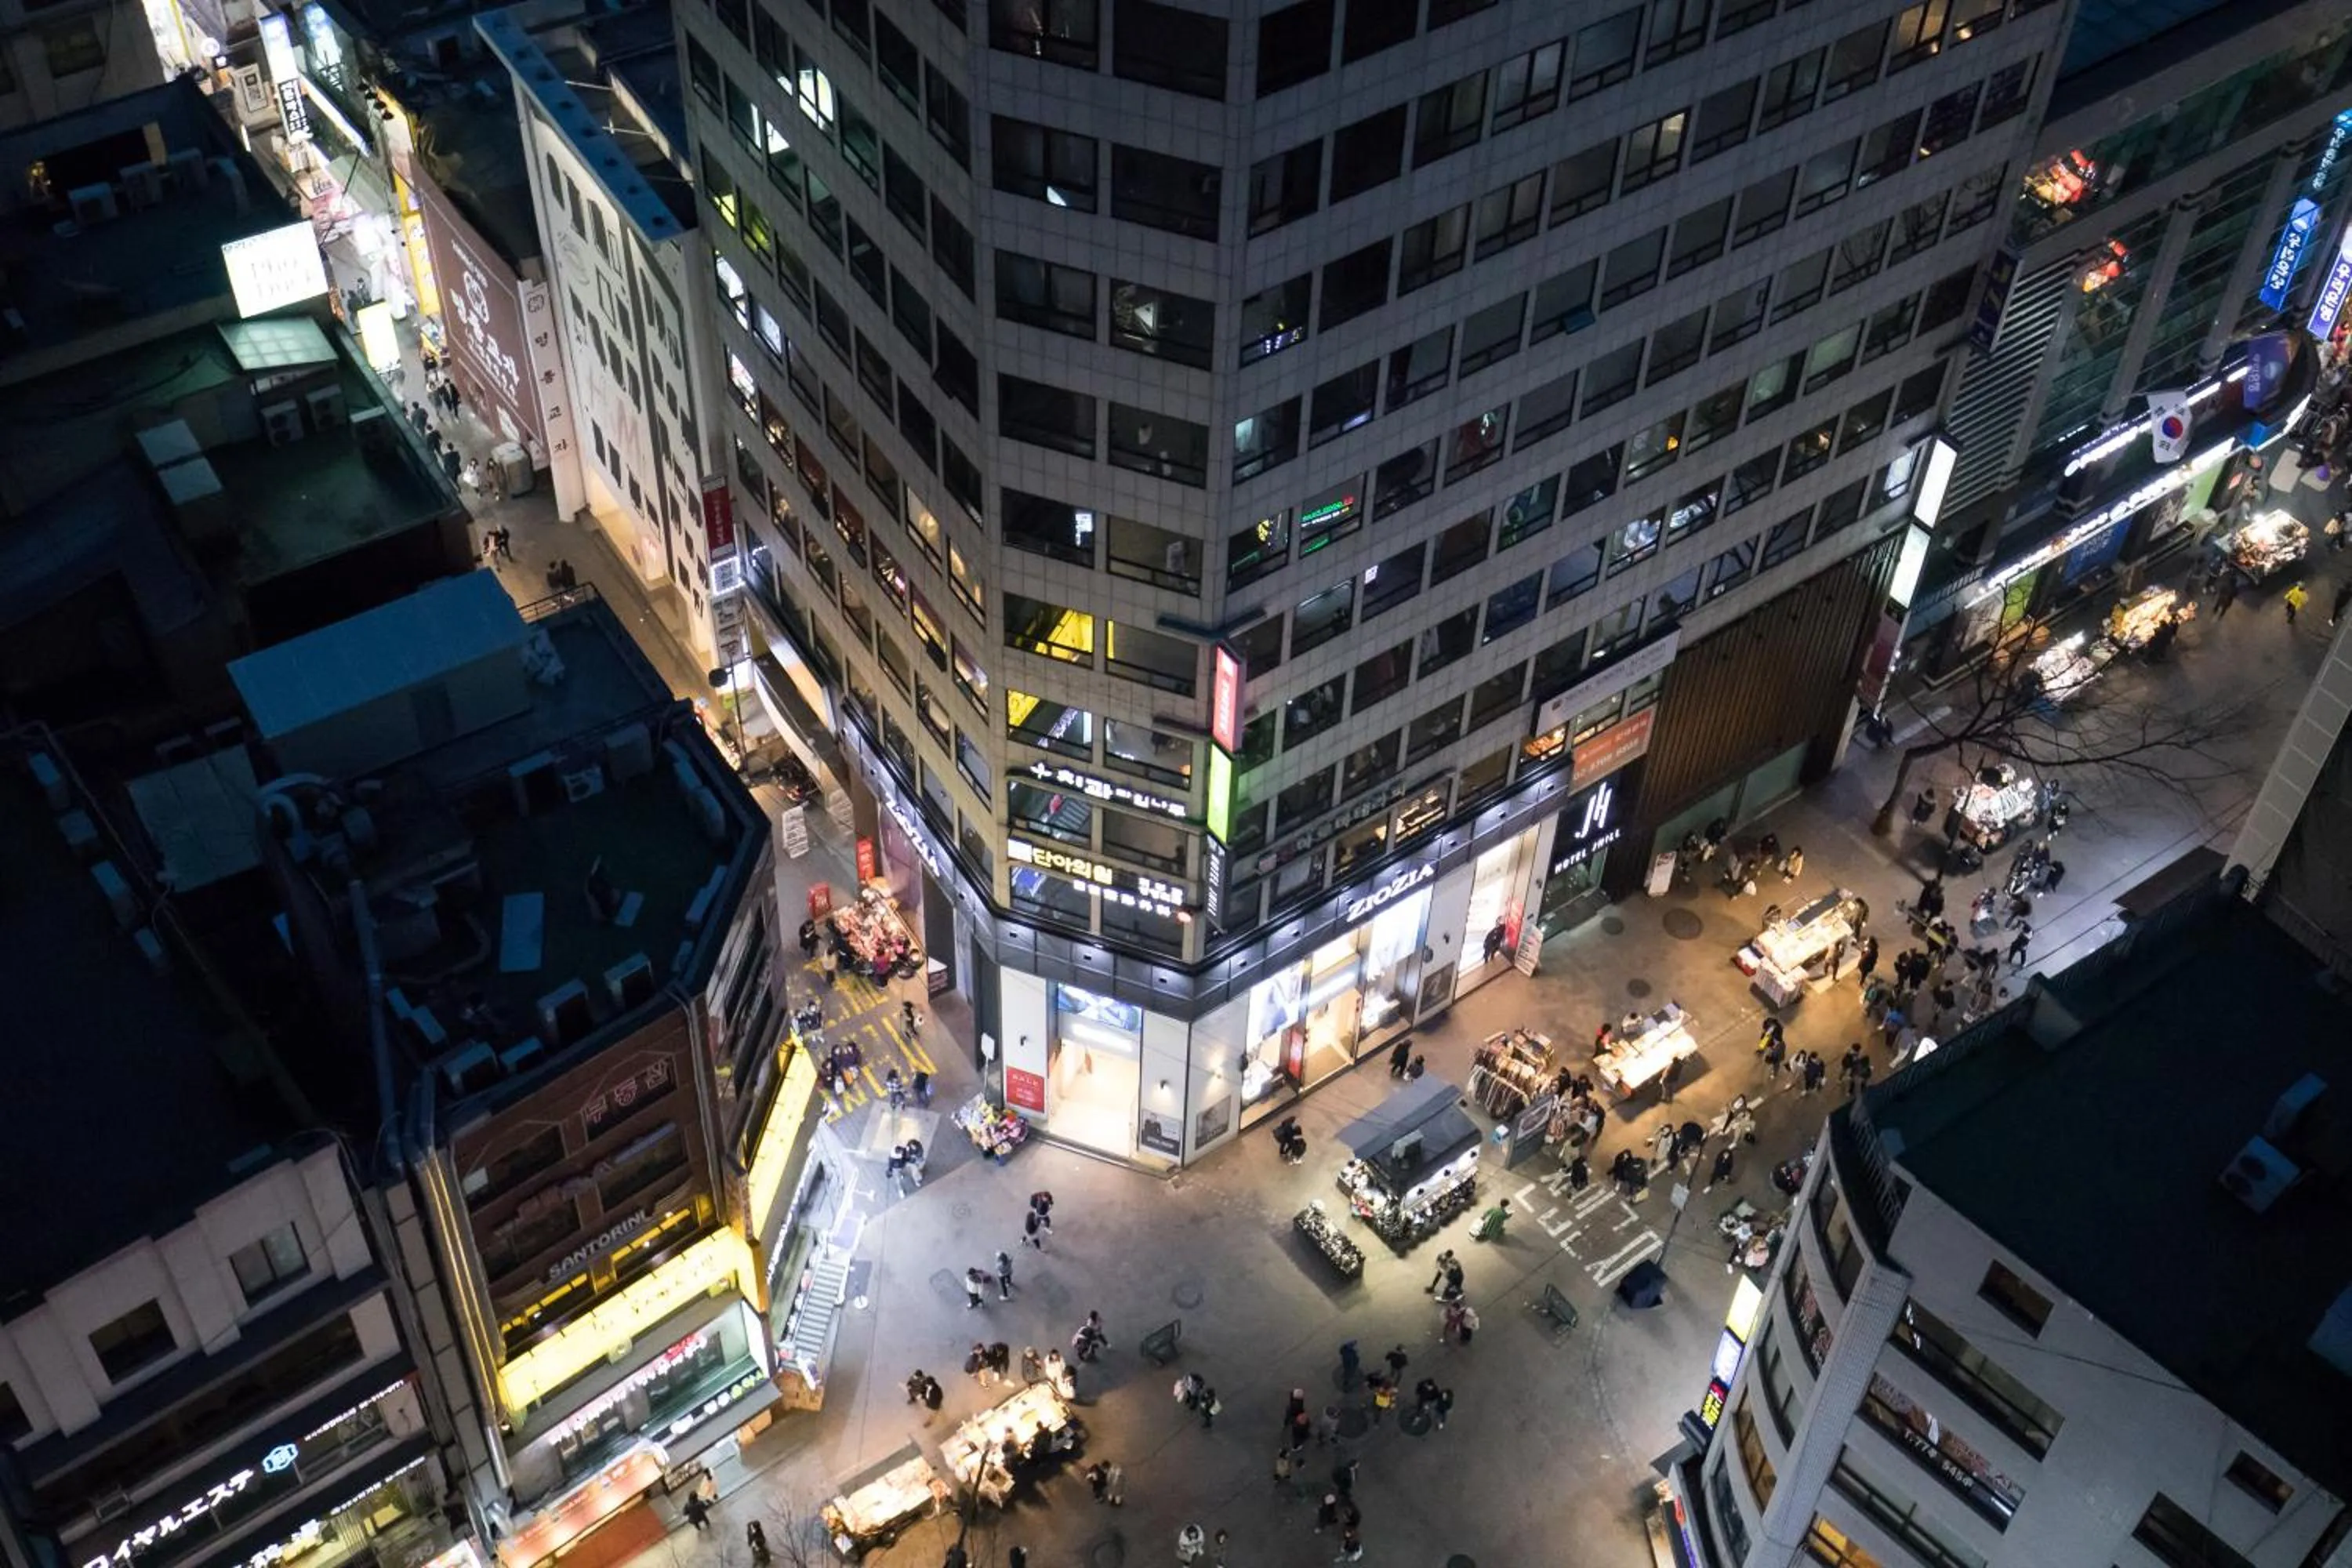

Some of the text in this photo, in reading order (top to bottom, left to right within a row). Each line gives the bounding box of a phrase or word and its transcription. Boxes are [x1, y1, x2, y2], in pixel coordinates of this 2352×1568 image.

[1056, 768, 1113, 800] 치과
[1032, 847, 1113, 886] 단아의원
[1554, 850, 1588, 874] HOTEL
[1346, 863, 1435, 923] ZIOZIA
[549, 1210, 648, 1281] SANTORINI
[82, 1468, 255, 1568] ロイヤルエステ
